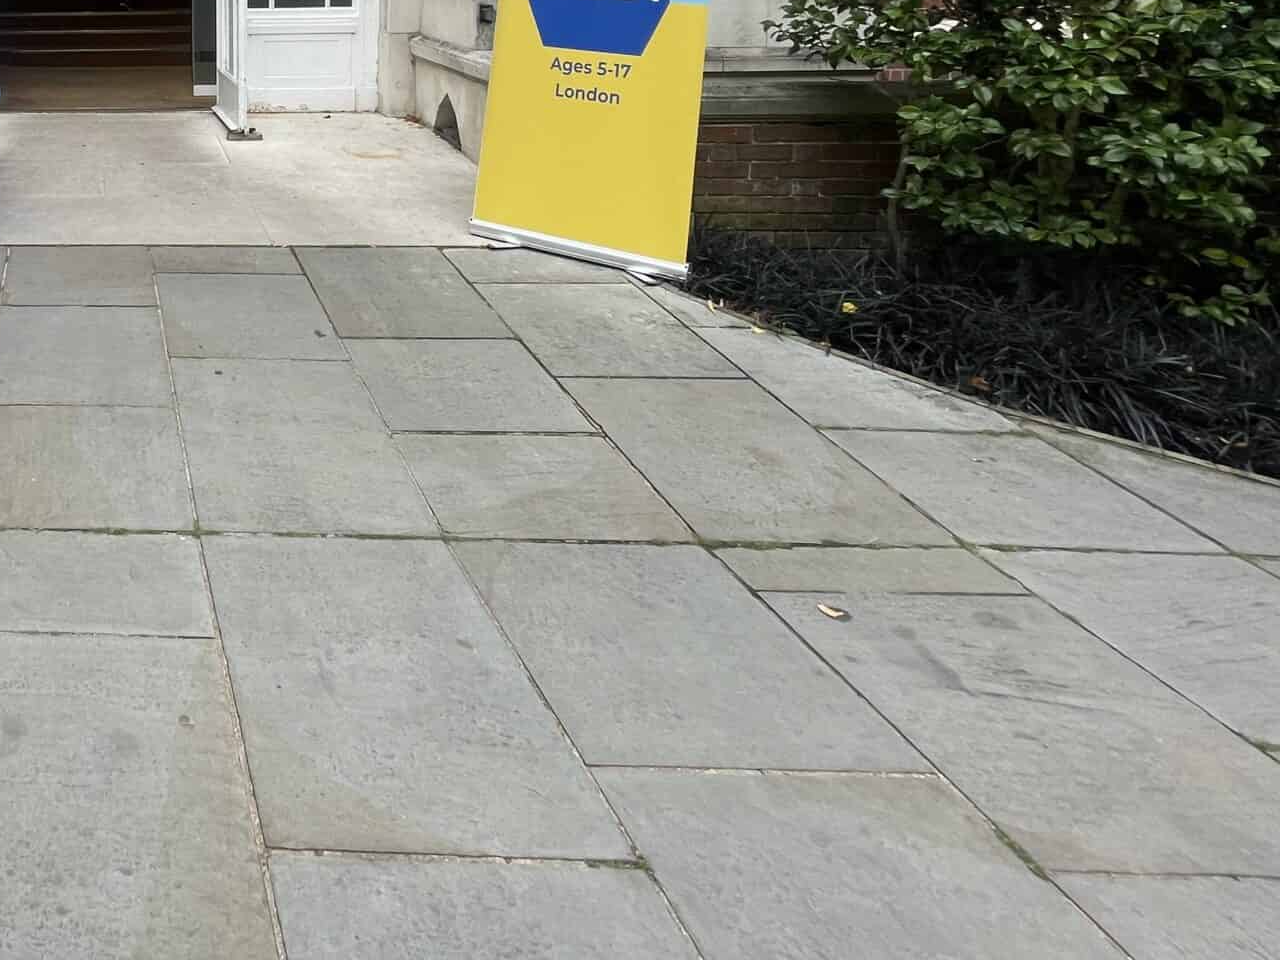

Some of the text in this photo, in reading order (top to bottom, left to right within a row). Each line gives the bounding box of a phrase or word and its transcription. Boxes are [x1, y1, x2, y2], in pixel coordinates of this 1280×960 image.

[550, 56, 631, 79] Ages 5-17
[554, 84, 621, 105] London
